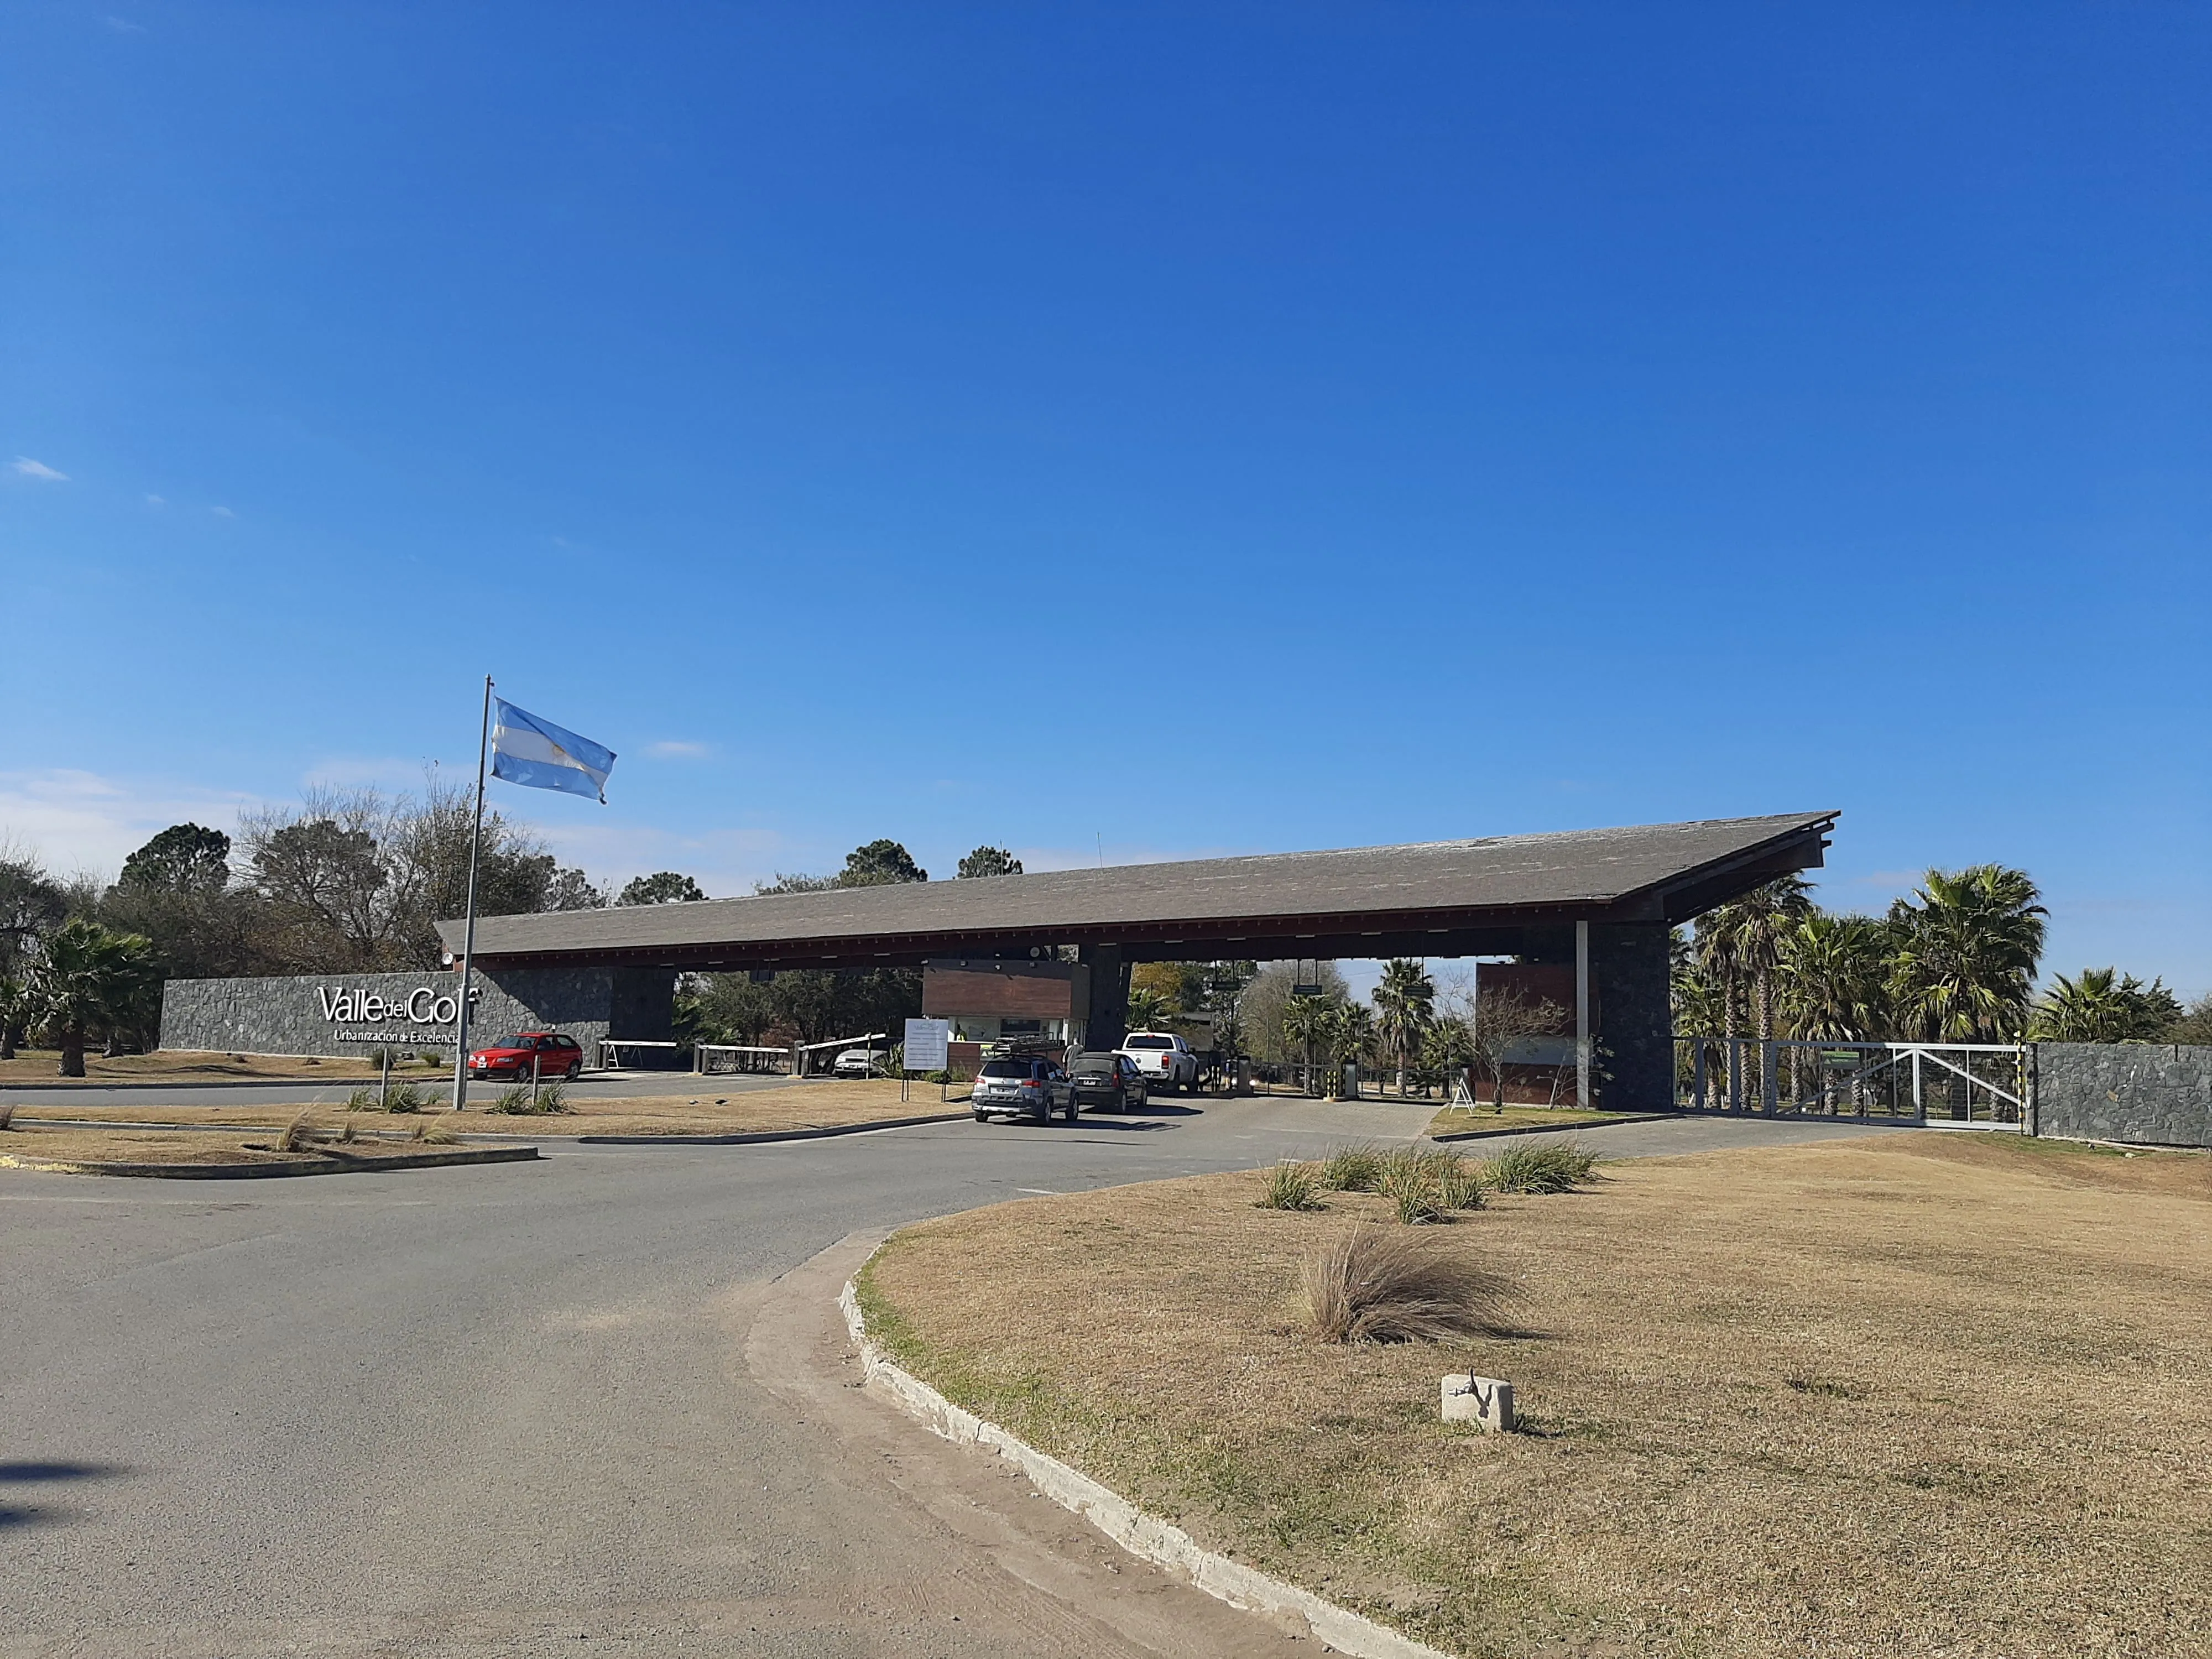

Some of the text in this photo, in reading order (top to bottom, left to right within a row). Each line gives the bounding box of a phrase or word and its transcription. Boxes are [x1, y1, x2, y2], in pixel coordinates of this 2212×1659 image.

[317, 987, 384, 1021] Valle
[383, 1000, 408, 1018] del
[399, 1034, 408, 1042] de
